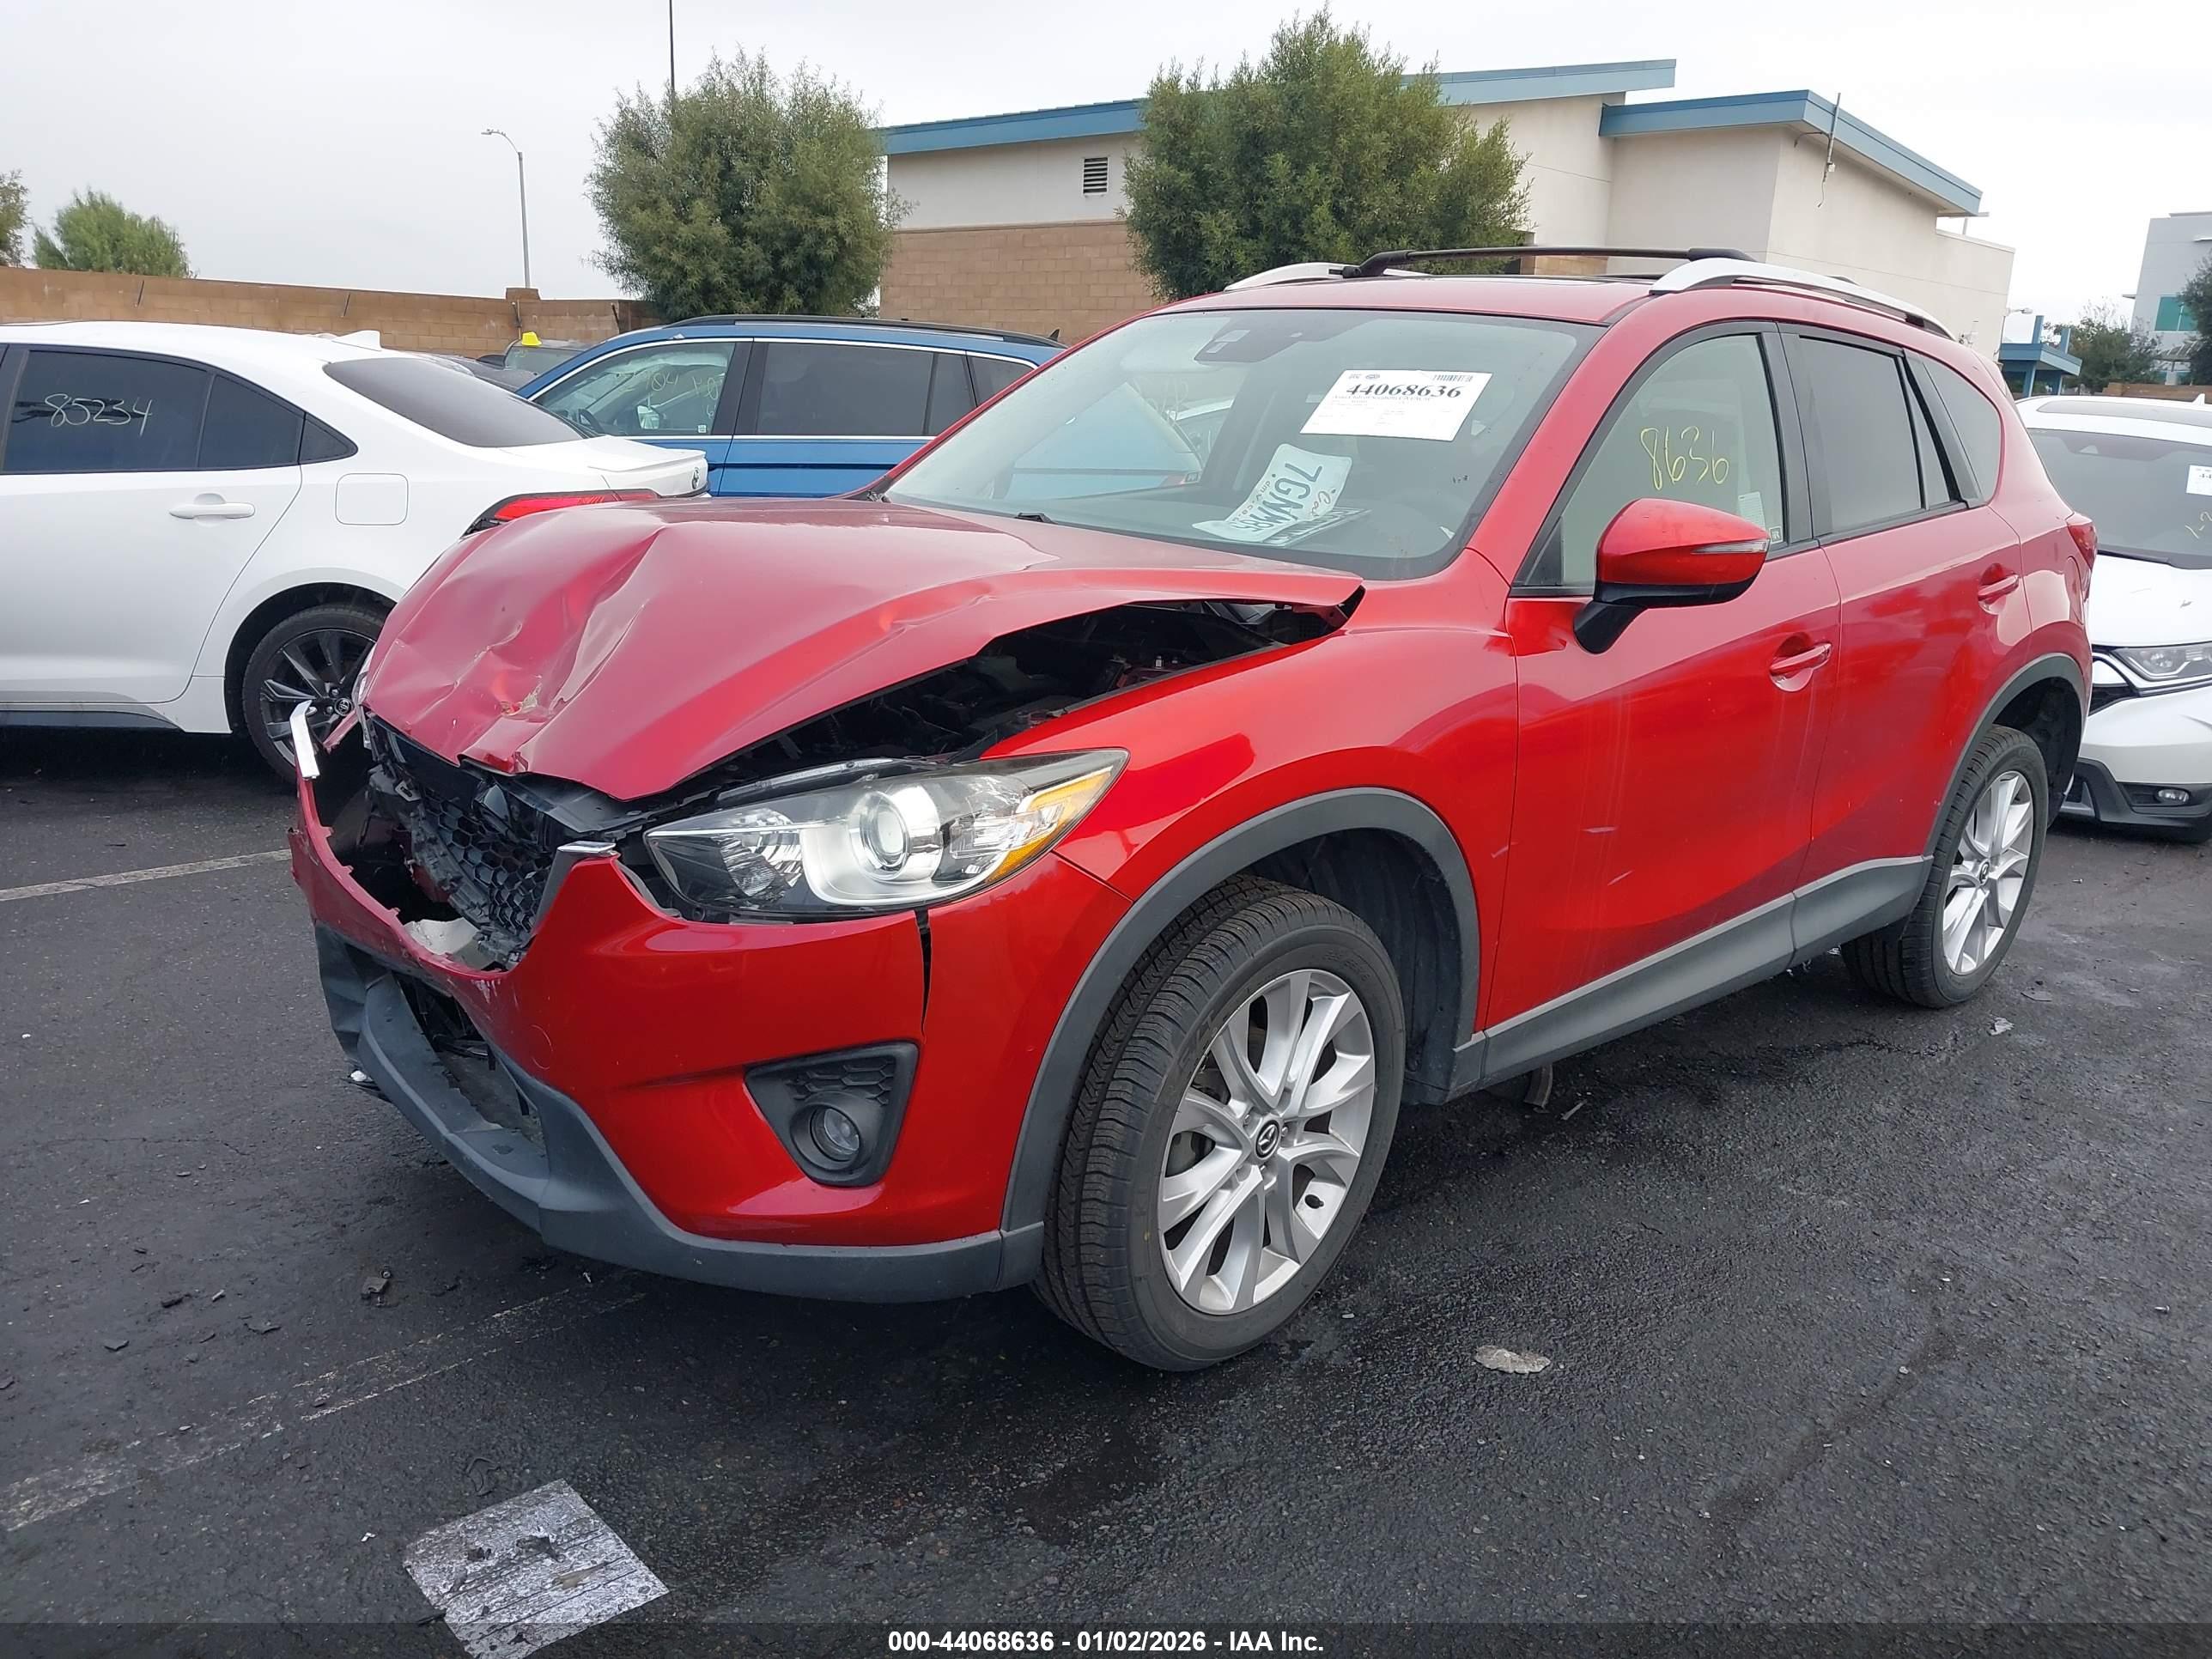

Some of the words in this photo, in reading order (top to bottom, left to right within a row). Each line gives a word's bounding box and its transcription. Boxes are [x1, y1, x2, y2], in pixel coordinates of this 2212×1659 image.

[1346, 384, 1465, 398] 44068636
[45, 392, 154, 437] 85234
[1639, 426, 1730, 491] 8636
